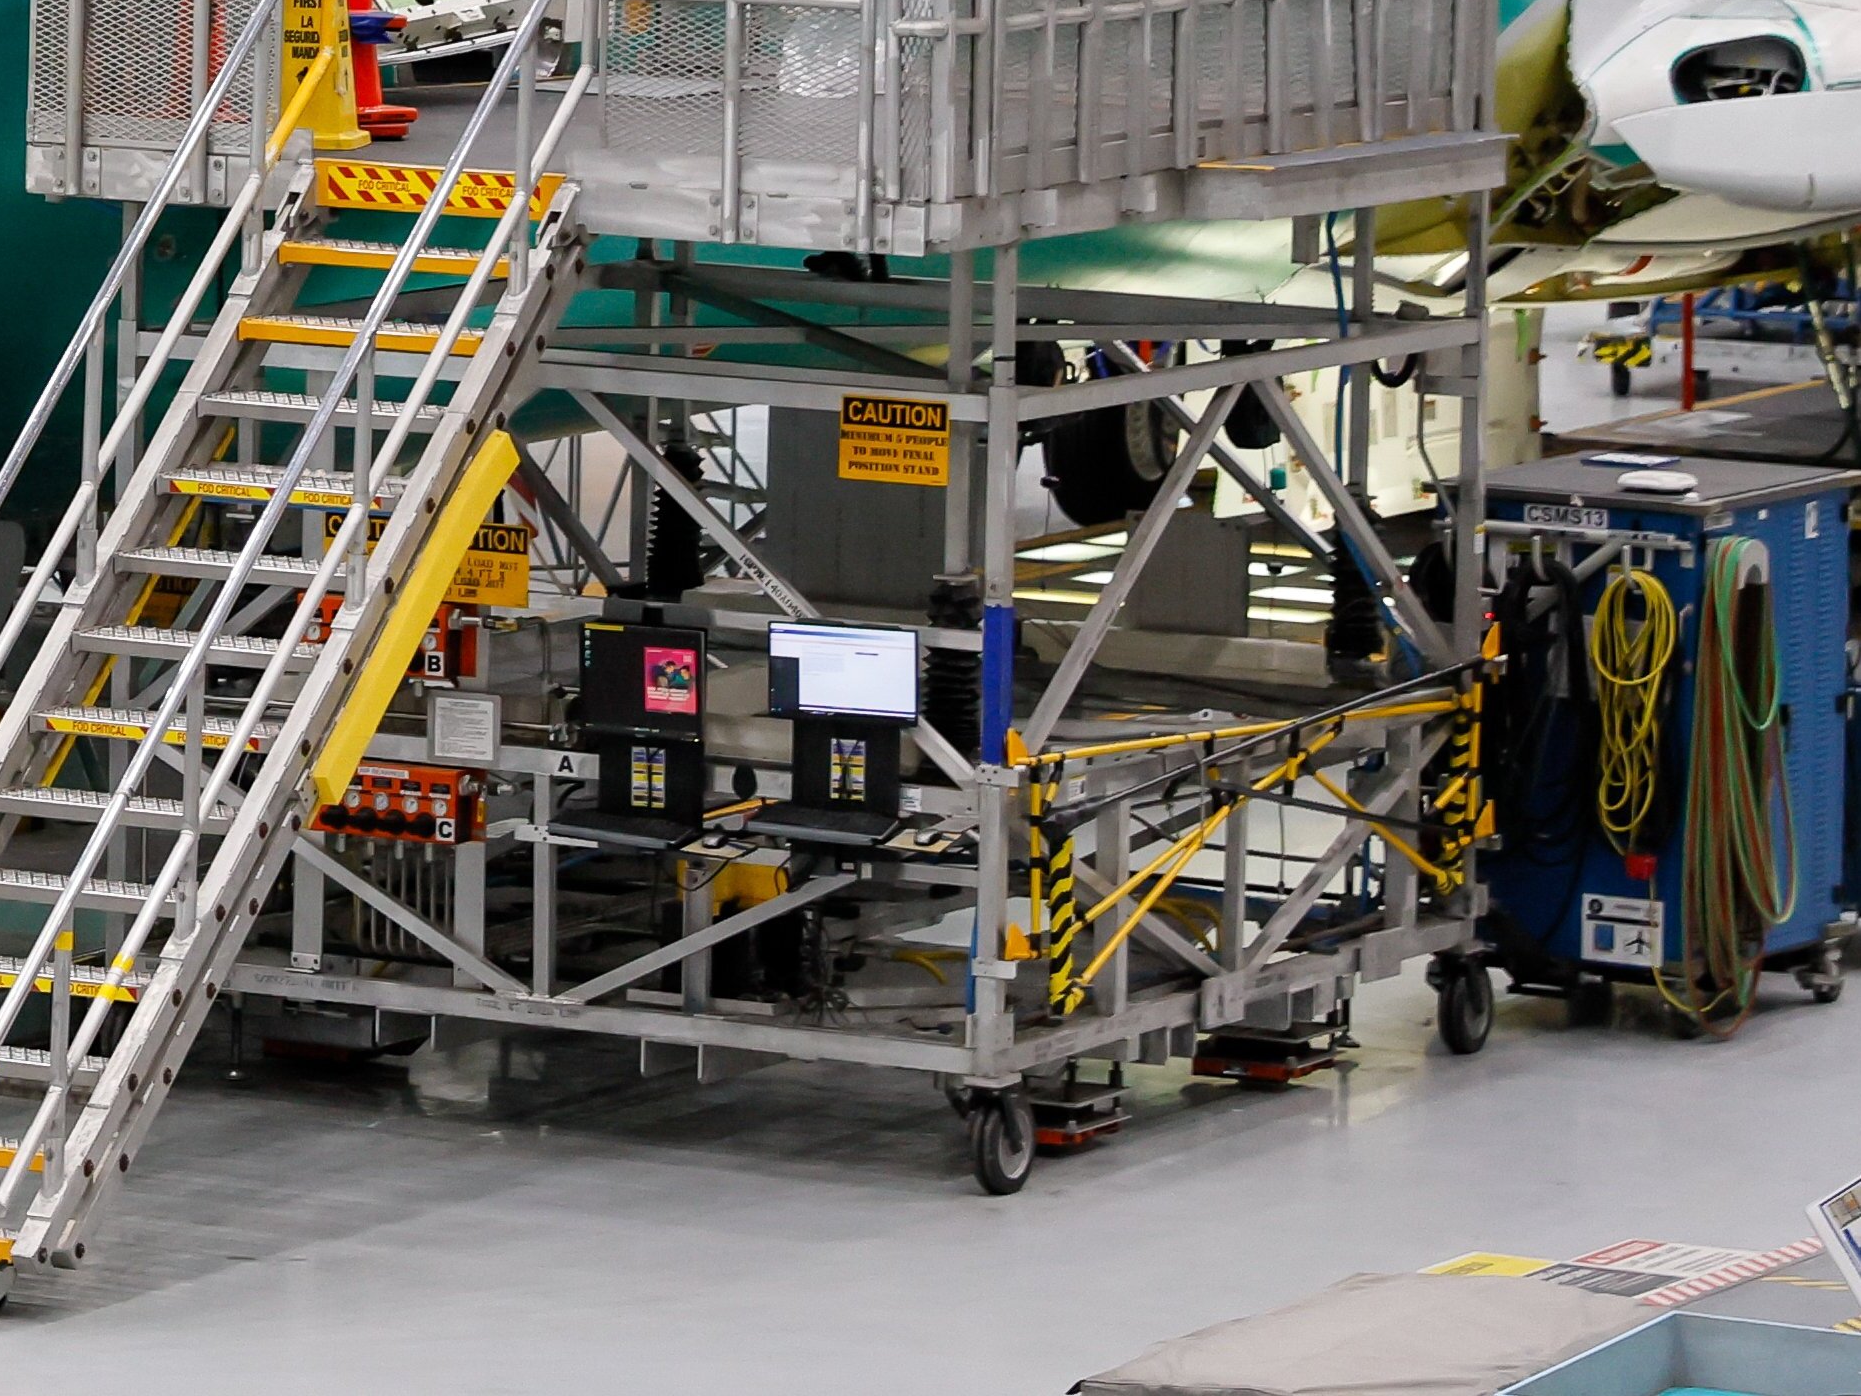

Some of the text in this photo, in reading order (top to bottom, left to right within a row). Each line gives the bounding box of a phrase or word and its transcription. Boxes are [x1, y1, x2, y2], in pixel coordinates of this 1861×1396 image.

[301, 15, 313, 28] LA
[358, 179, 411, 192] FOD CRITICAL
[462, 186, 479, 196] FOD
[848, 401, 942, 428] CAUTION
[905, 435, 948, 446] PEOPLE
[852, 446, 866, 455] TO
[848, 460, 940, 476] POSITION STAND
[198, 483, 251, 497] FOD CRITICAL
[303, 493, 352, 505] FOD CRITICA
[1528, 505, 1604, 527] CSMS13
[479, 528, 525, 552] TION
[427, 655, 441, 673] B
[73, 721, 126, 736] FOD CRITICAL
[558, 755, 574, 773] A
[438, 821, 453, 838] C
